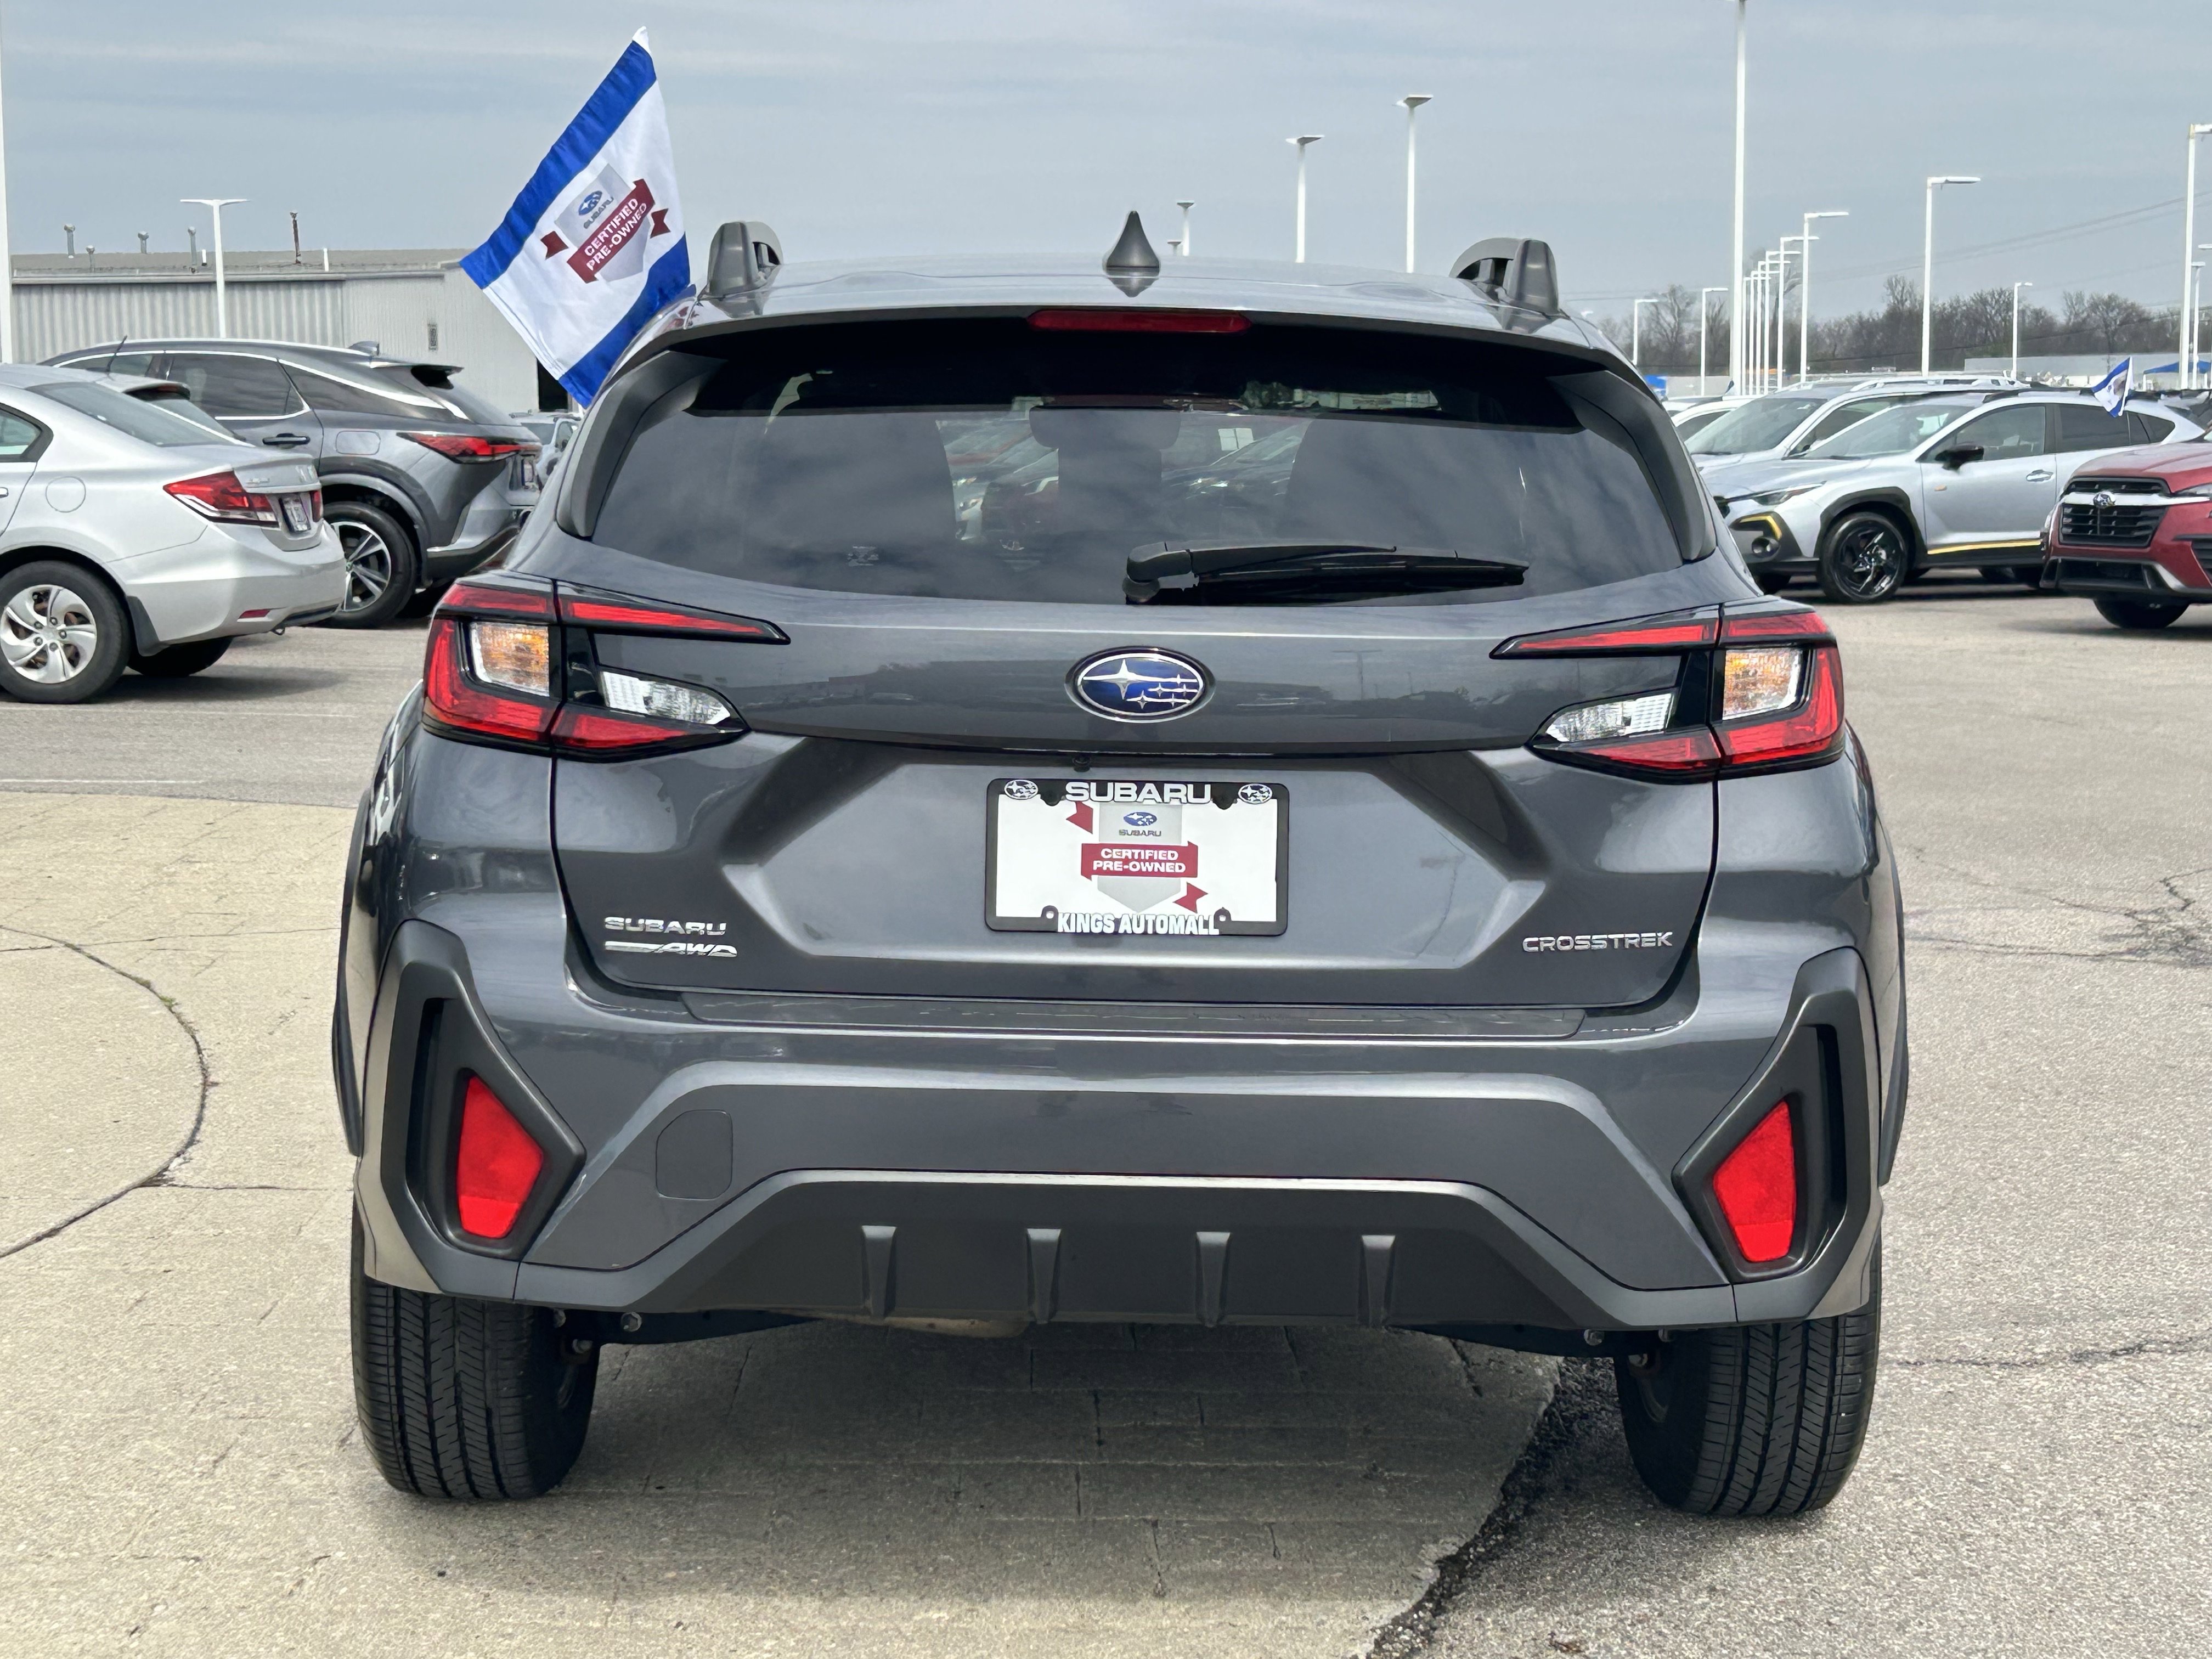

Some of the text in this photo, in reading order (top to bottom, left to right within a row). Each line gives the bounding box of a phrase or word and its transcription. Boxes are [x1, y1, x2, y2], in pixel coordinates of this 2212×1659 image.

[584, 196, 614, 229] SUBARU
[584, 198, 639, 256] CERTIFIED
[586, 202, 647, 270] PRE-OWNED
[1065, 781, 1211, 804] SUBARU
[1119, 828, 1162, 837] SUBARU
[1101, 848, 1179, 861] CERTIFIED
[1093, 860, 1186, 873] PRE-OWNED
[605, 916, 727, 936] SUBARU
[1057, 912, 1220, 935] KINGS AUTOMALL
[655, 942, 738, 957] AWD
[1522, 932, 1673, 952] CROSSTREK
